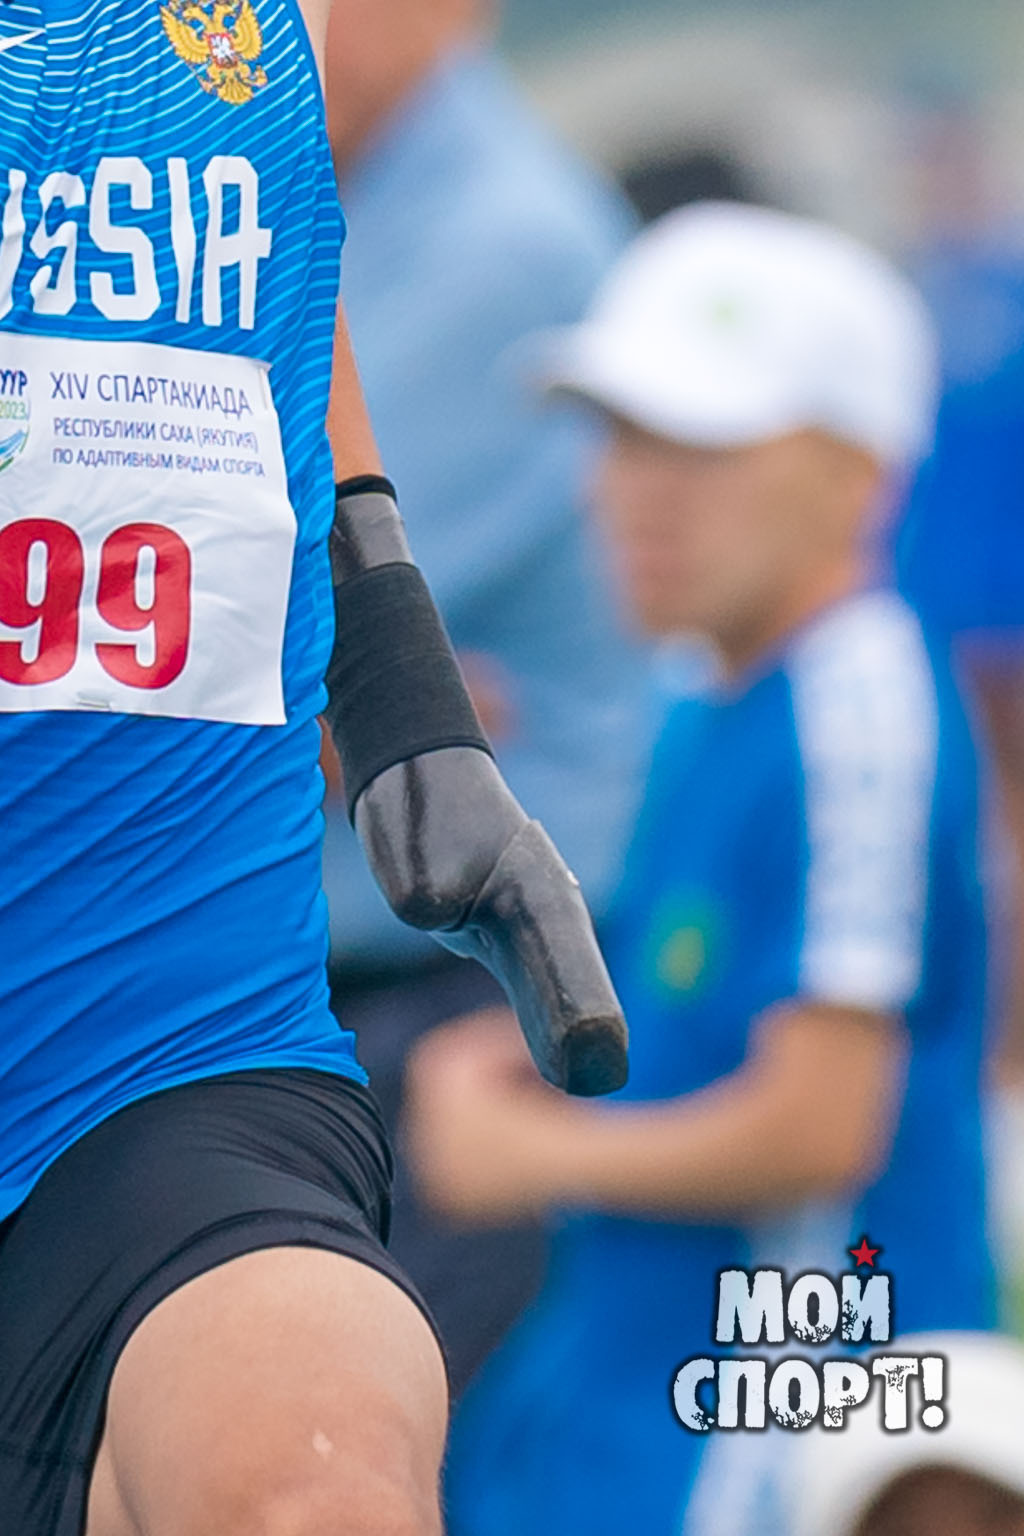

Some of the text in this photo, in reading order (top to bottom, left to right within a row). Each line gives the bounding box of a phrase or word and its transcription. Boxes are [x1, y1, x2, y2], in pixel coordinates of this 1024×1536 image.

[97, 374, 254, 420] СПАРТАКИАДА
[54, 417, 258, 454] РЕСПУБЛИКИ САХА (ЯКУТИЯ)
[53, 448, 266, 477] ПО АДАПТИВНЫМ ВИДАМ СПОРТА
